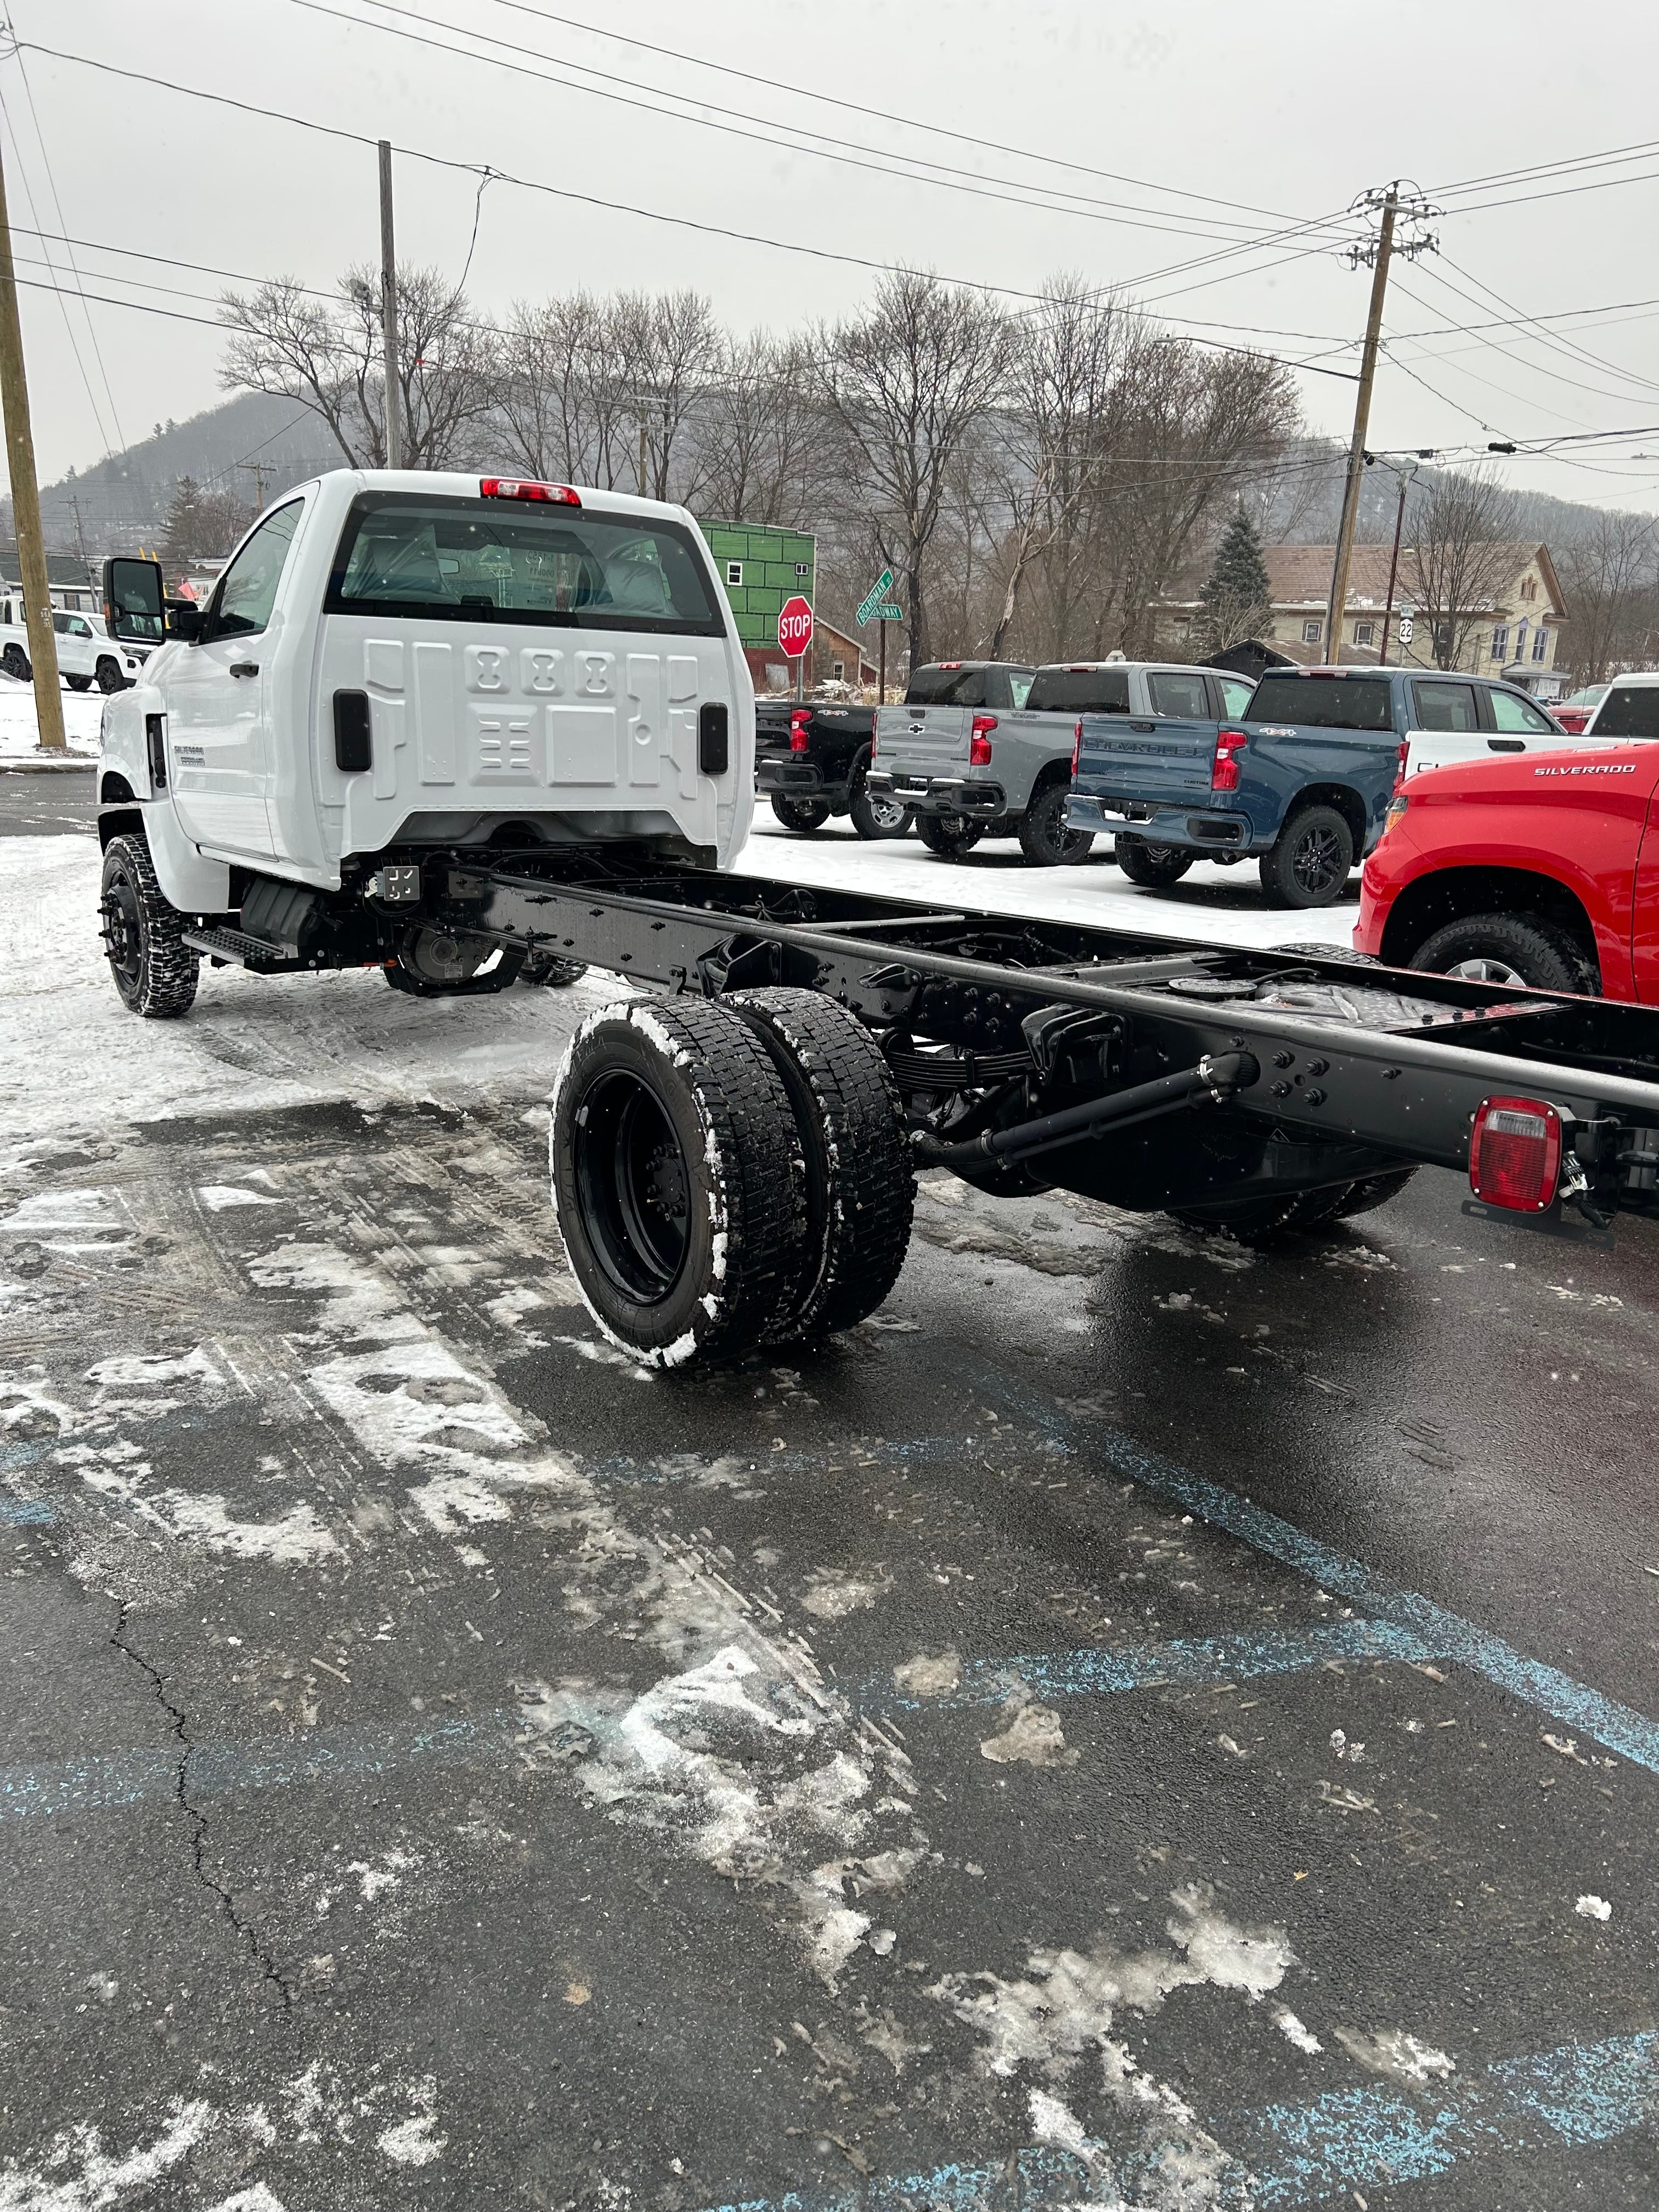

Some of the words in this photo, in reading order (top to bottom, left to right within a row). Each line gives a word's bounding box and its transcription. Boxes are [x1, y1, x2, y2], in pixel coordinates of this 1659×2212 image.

[859, 580, 887, 623] BOARDMAN
[871, 607, 899, 618] OADWAY
[780, 614, 810, 640] STOP
[1401, 623, 1412, 637] 22
[1085, 738, 1203, 756] CHEVROLET
[1534, 765, 1637, 777] SILVERADO
